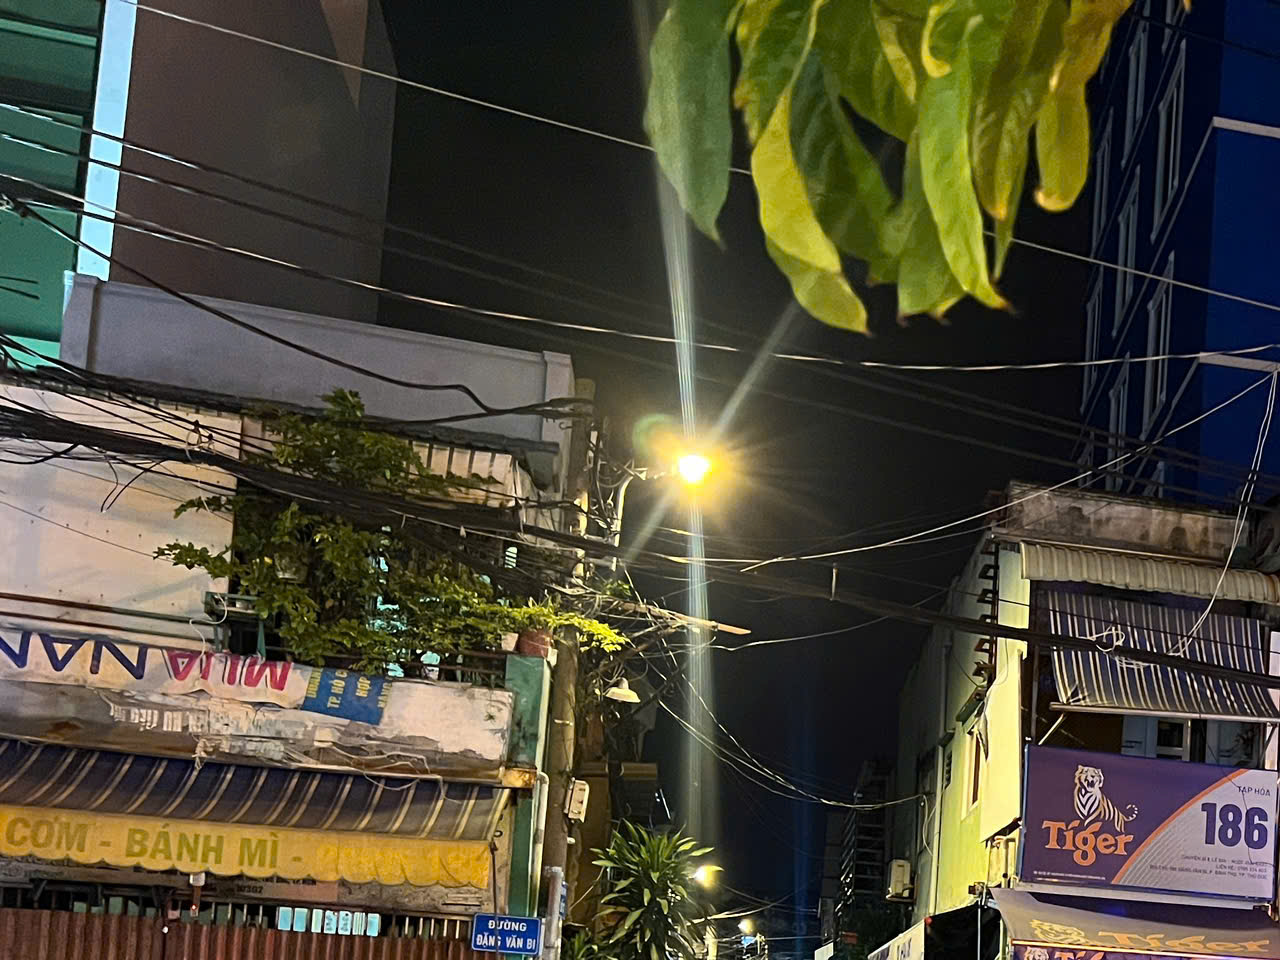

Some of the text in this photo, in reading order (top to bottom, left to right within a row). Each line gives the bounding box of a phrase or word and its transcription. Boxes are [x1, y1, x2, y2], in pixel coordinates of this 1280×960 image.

[125, 823, 225, 865] BÁNH
[238, 831, 279, 869] MÌ
[1041, 820, 1135, 866] Tiger
[1201, 802, 1269, 850] 186
[488, 918, 528, 932] ĐƯỜNG
[505, 934, 524, 949] VĂN
[526, 938, 536, 950] BI
